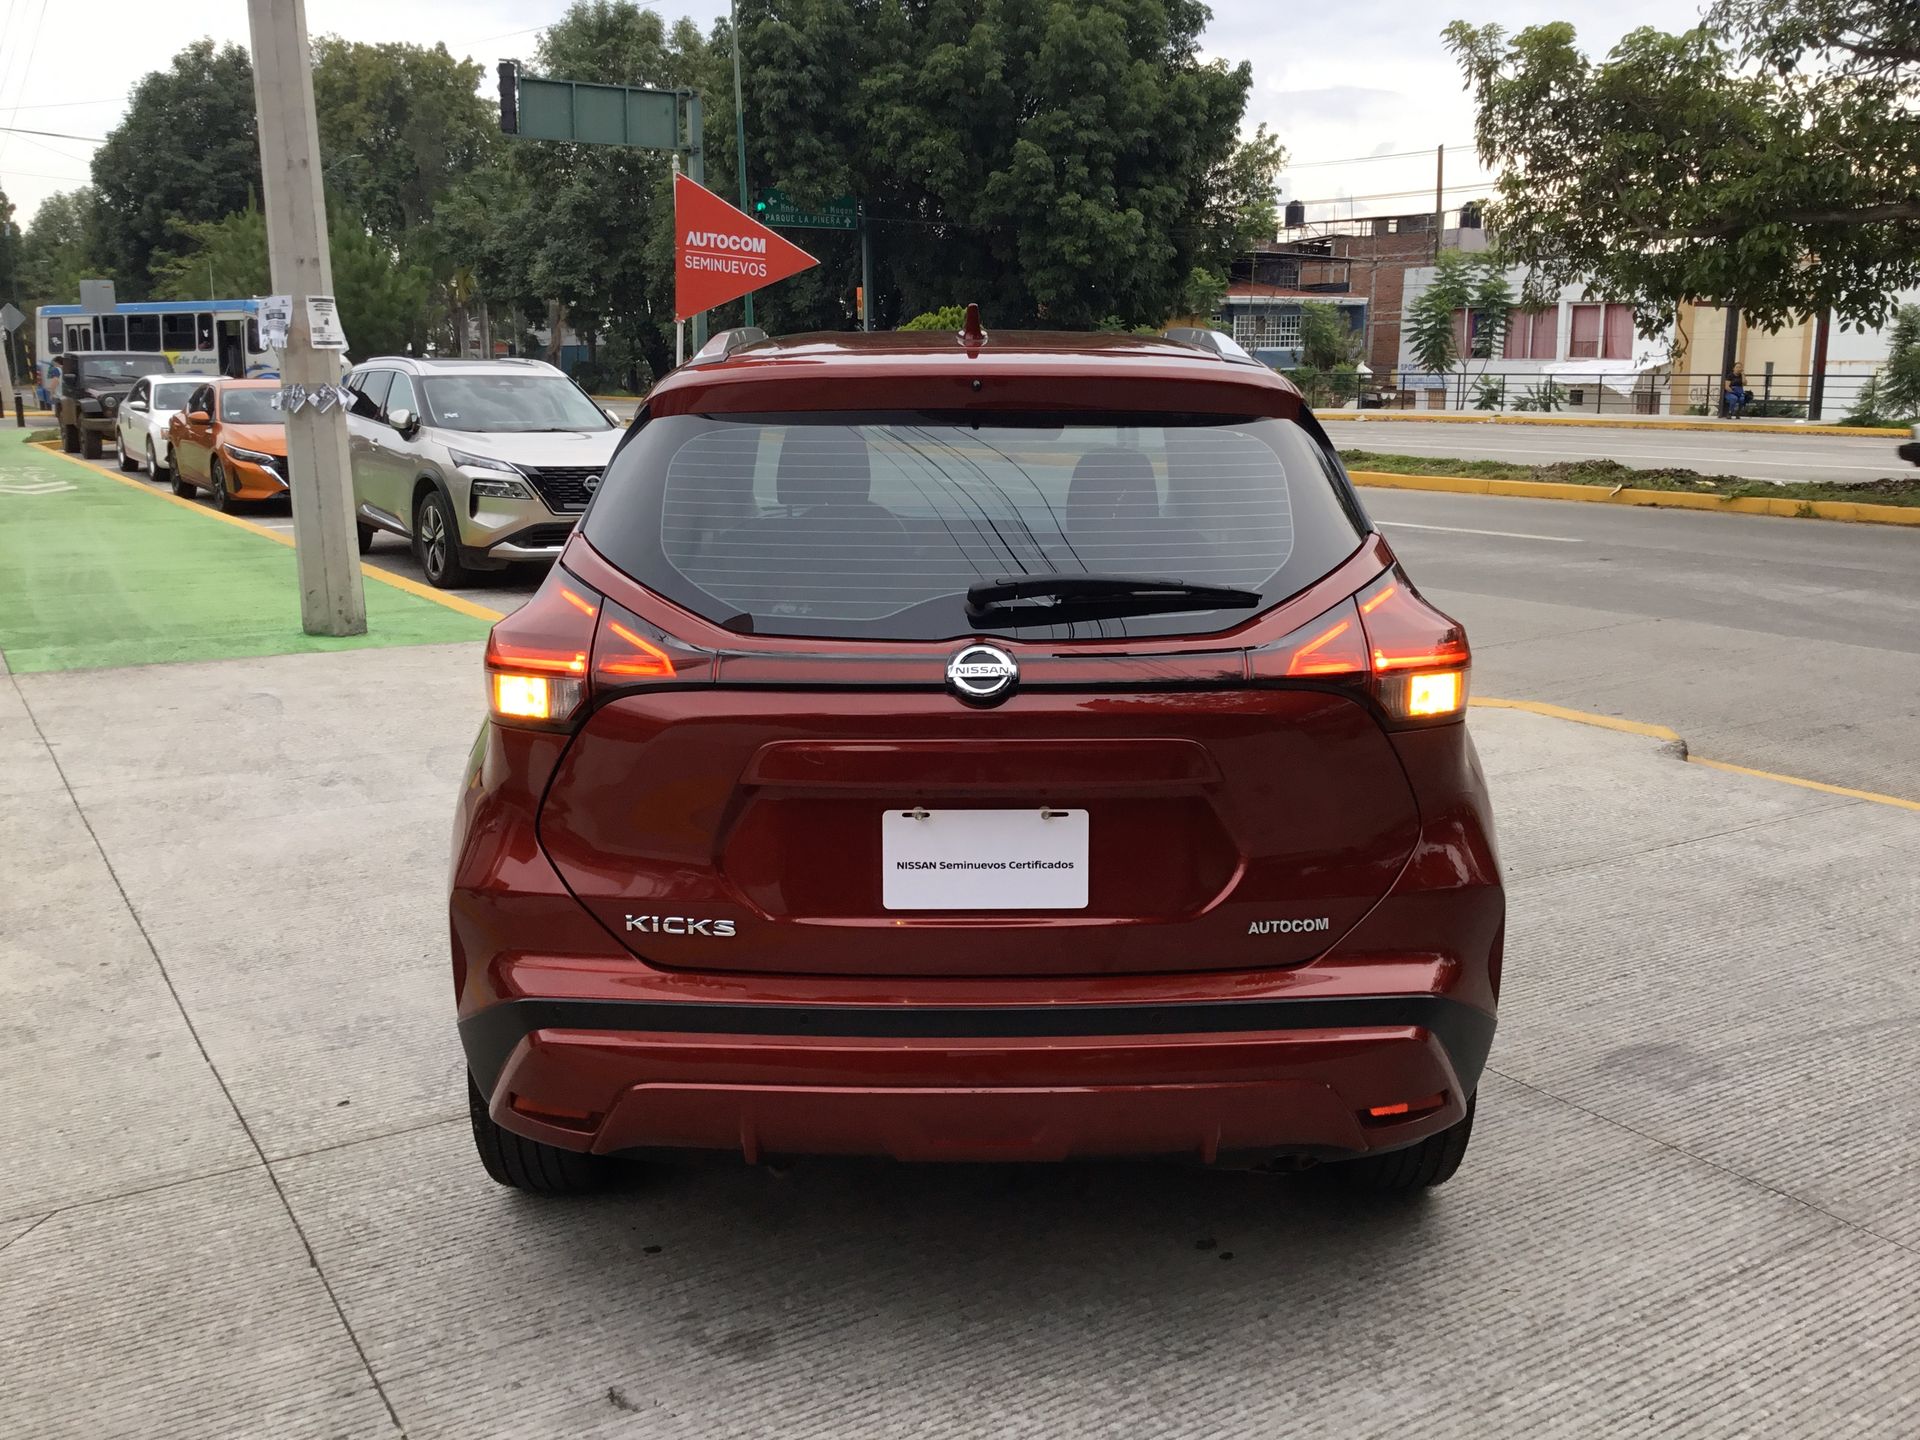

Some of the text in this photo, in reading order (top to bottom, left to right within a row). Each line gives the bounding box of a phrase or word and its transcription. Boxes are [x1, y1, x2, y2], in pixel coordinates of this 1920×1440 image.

[765, 213, 795, 223] PARQUE
[798, 215, 809, 224] LA
[685, 231, 766, 254] AUTOCOM
[685, 255, 768, 277] SEMINUEVOS
[955, 666, 1009, 674] NISSAN
[896, 860, 1074, 870] NISSAN Seminuevos Certificados
[625, 914, 736, 937] KICKS
[1248, 917, 1329, 934] AUTOCOM
